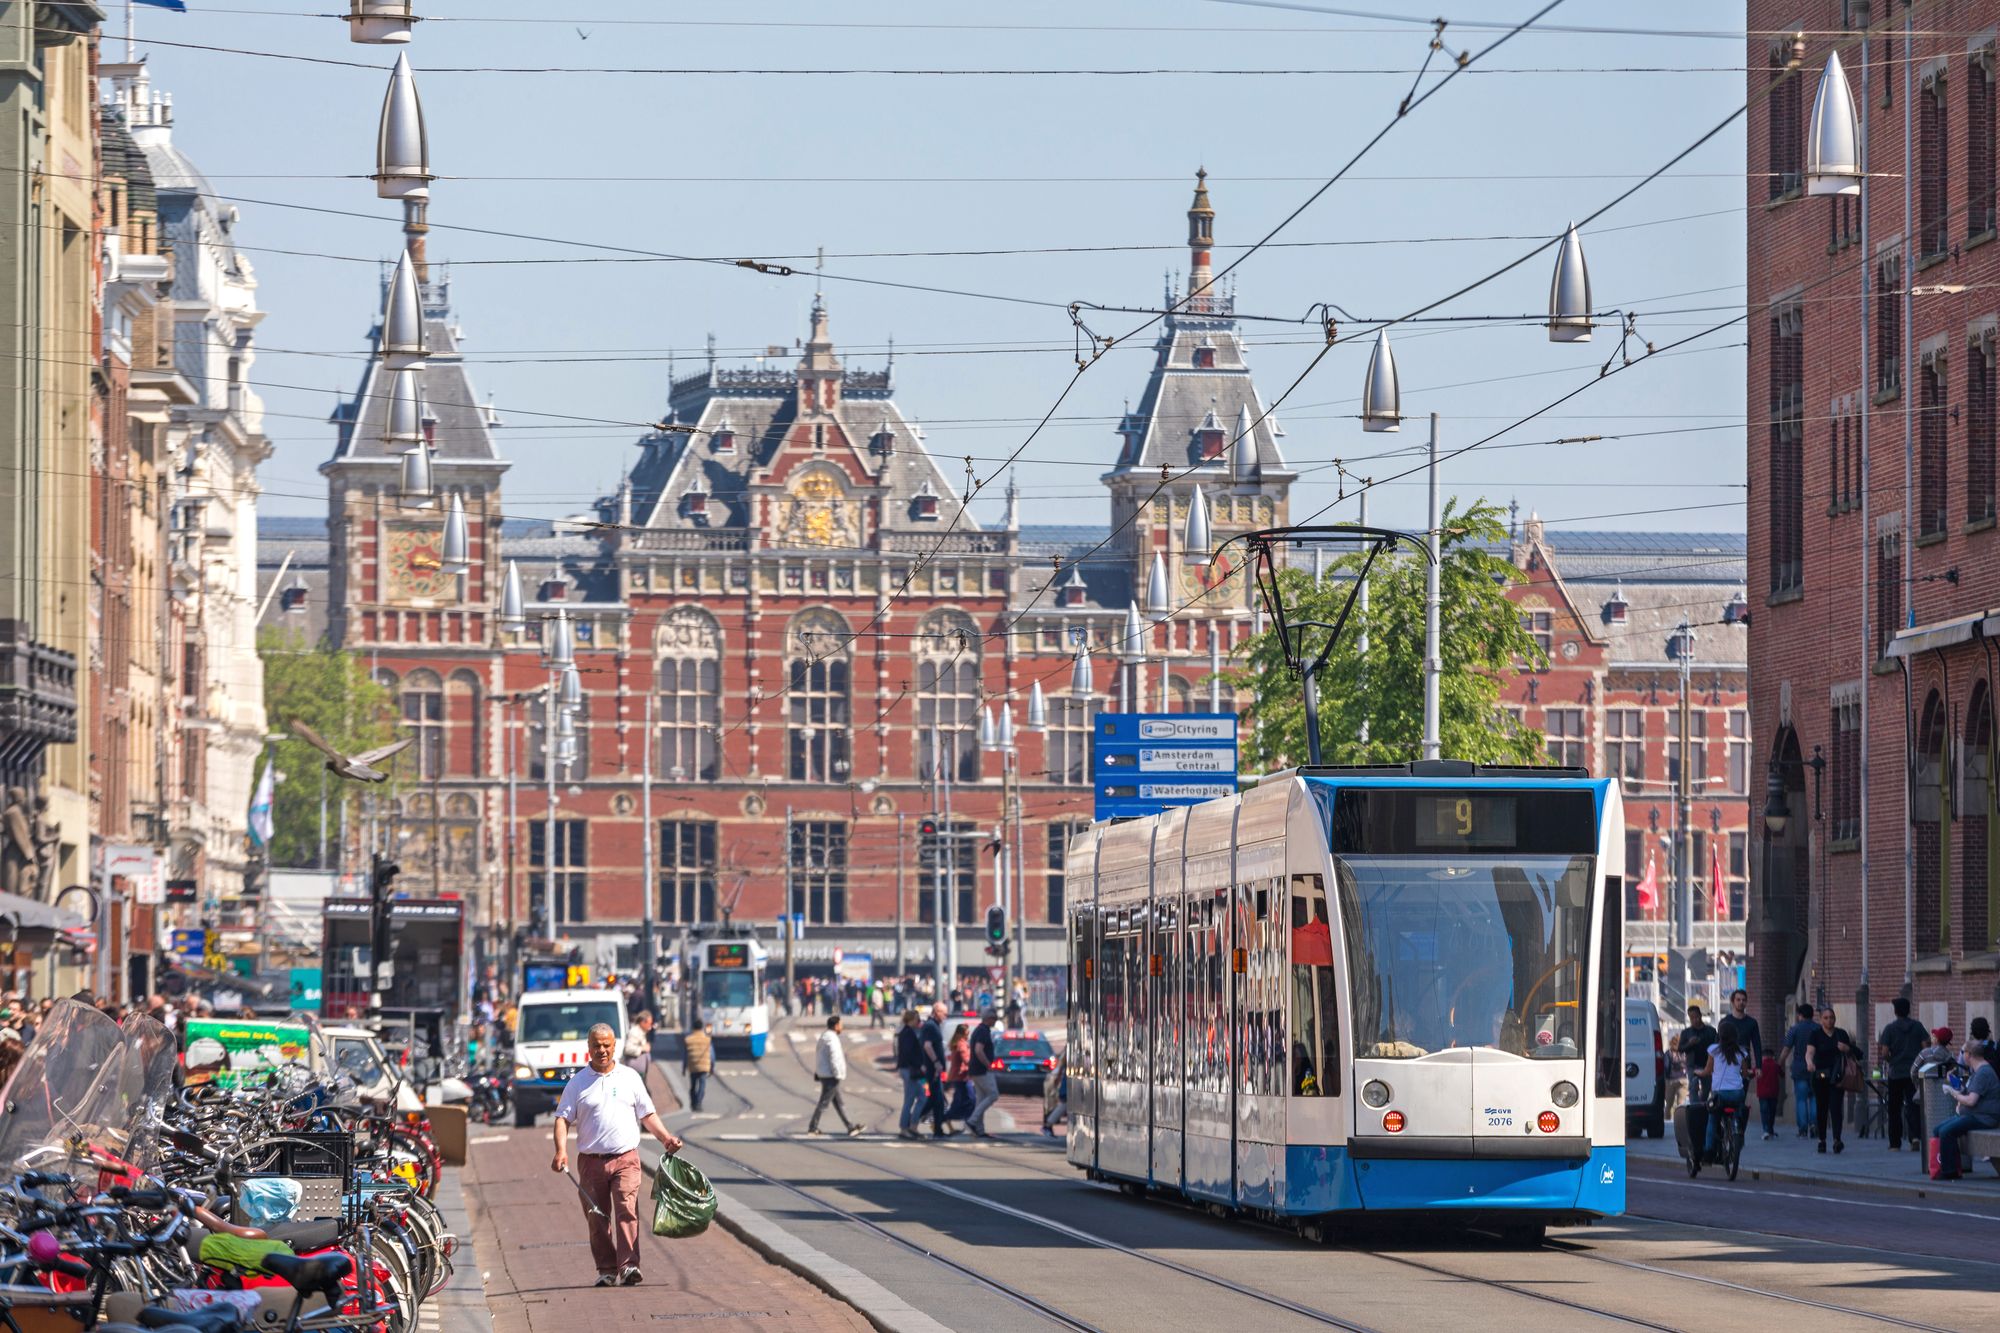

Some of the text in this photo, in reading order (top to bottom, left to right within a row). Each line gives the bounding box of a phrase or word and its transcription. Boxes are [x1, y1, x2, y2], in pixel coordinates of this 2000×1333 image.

[1176, 725, 1218, 735] Cityring
[1154, 751, 1213, 760] Amsterdam
[1176, 762, 1219, 770] Centraal
[1154, 787, 1229, 796] Waterlooplein
[1455, 798, 1472, 835] 9
[1488, 1117, 1513, 1126] 2076
